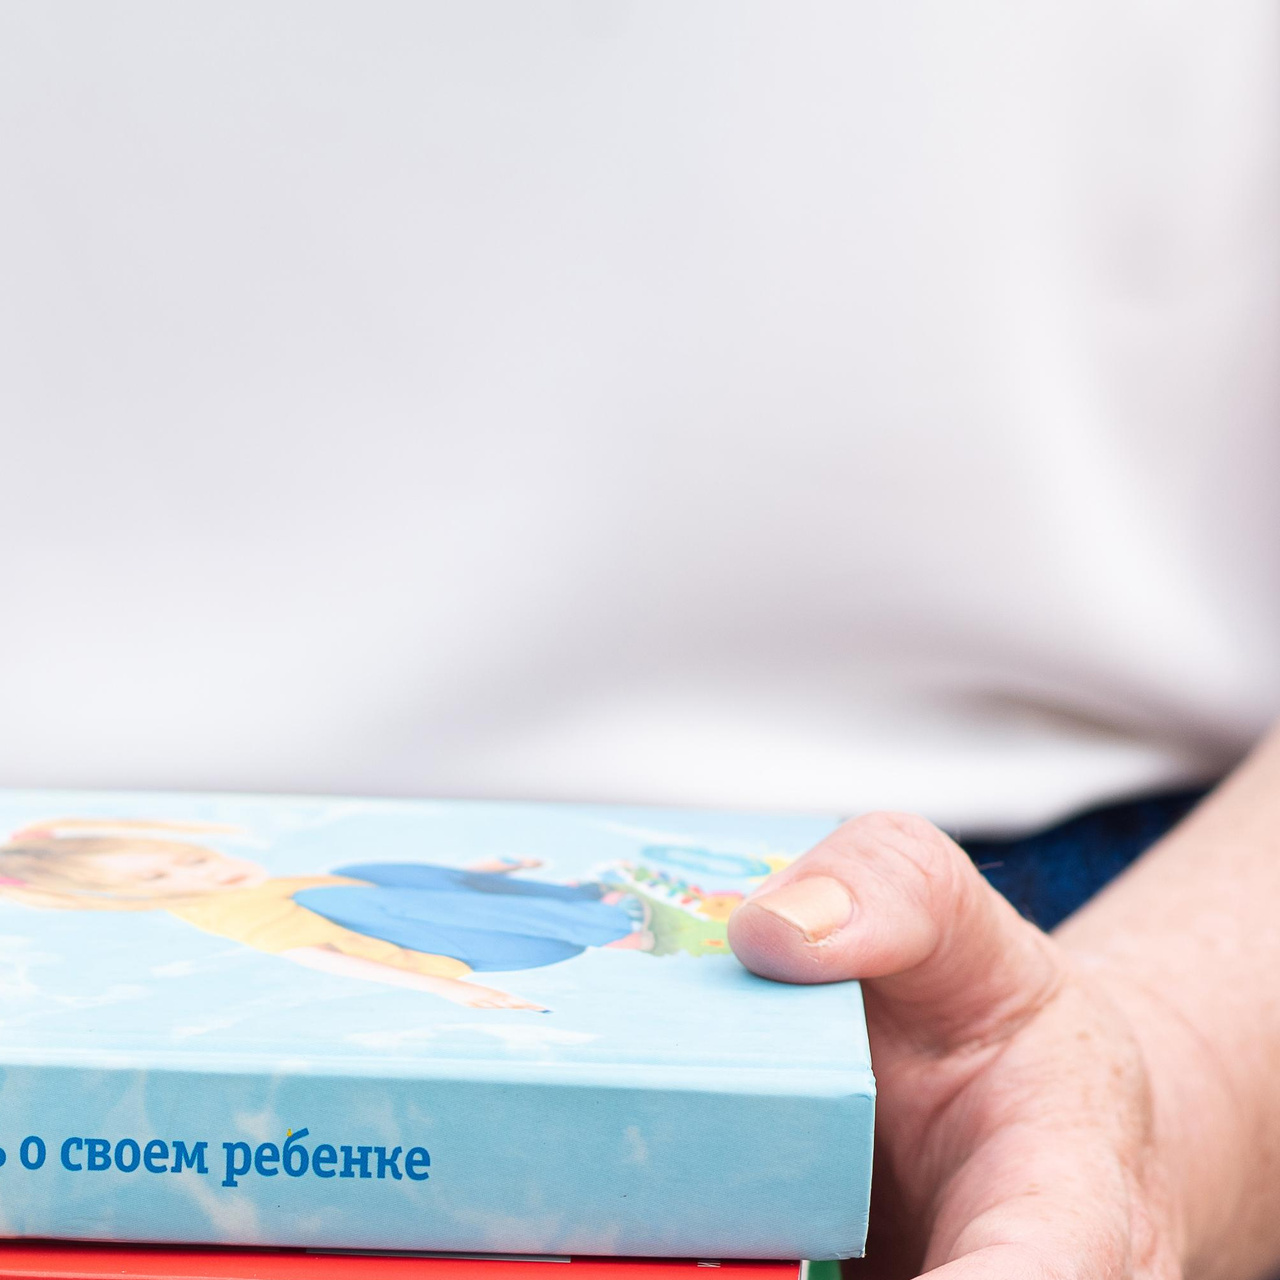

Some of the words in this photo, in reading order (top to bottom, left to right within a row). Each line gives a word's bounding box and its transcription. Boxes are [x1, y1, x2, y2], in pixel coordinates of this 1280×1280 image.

[19, 1135, 47, 1171] о
[60, 1136, 210, 1175] своем
[221, 1126, 432, 1188] ребенке
